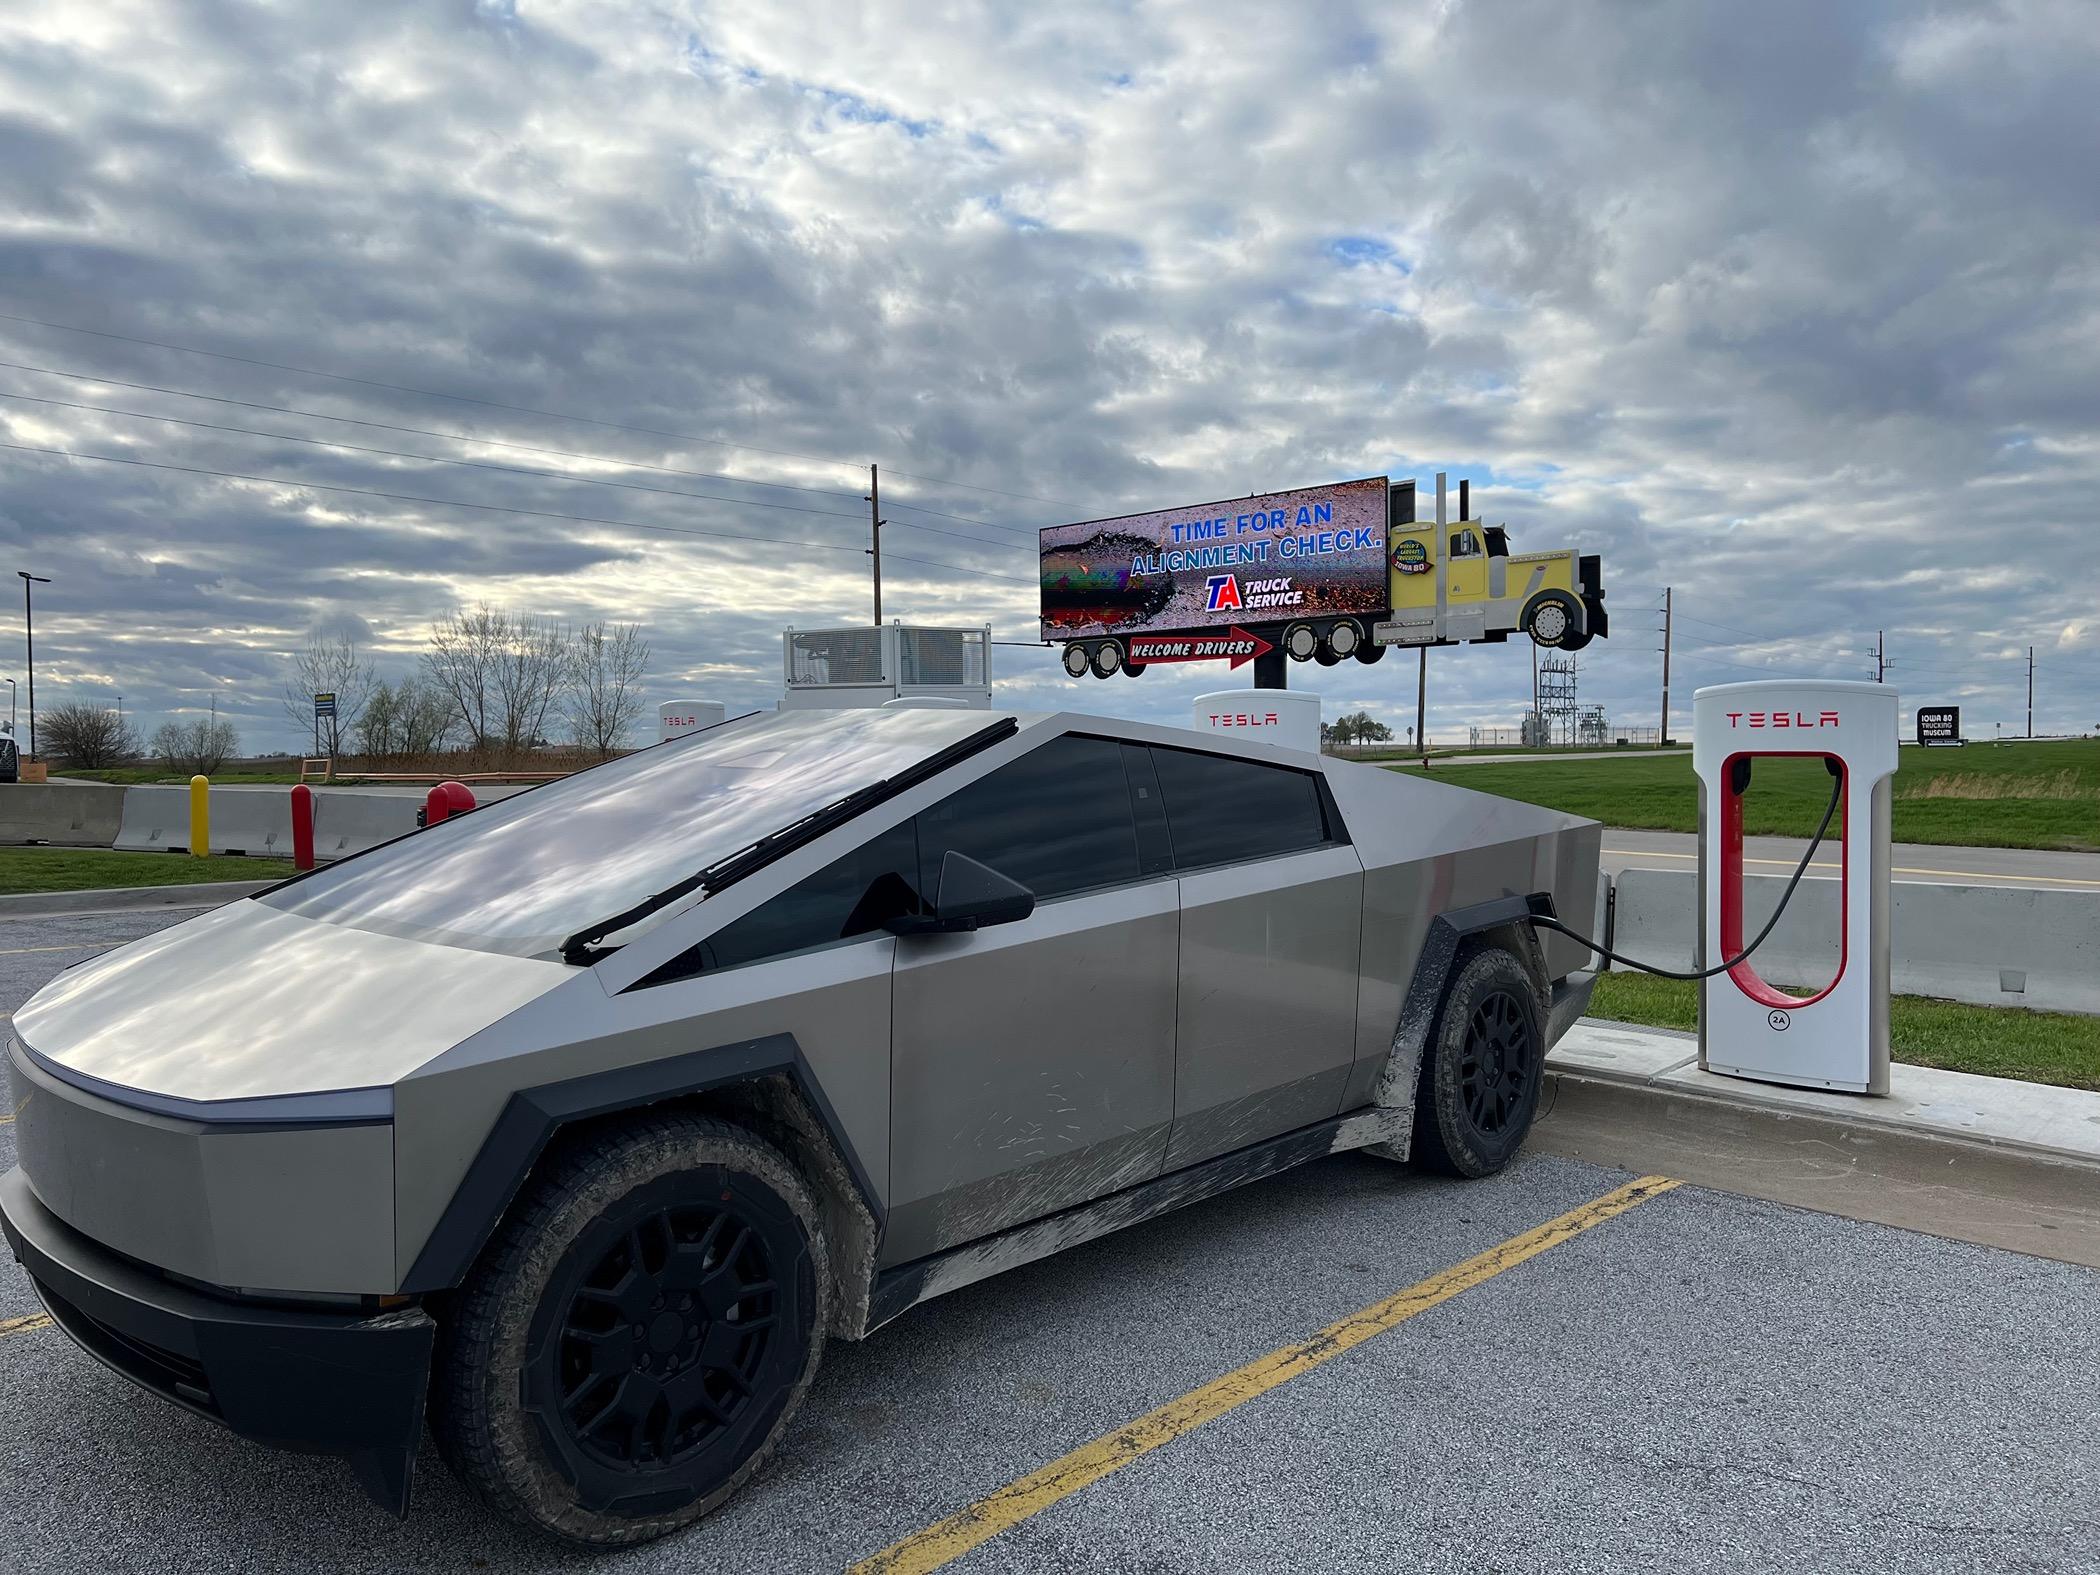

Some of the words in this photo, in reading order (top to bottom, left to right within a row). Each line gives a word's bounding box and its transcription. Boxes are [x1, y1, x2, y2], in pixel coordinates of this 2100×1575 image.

[1171, 517, 1227, 544] TIME
[1236, 508, 1287, 535] FOR
[1295, 502, 1333, 526] AN
[1130, 540, 1272, 577] ALIGNMENT
[1279, 527, 1383, 558] CHECK.
[1394, 561, 1412, 571] IOWA
[1413, 563, 1424, 571] 80
[1205, 573, 1243, 612] TA
[1245, 577, 1292, 594] TRUCK
[1131, 642, 1192, 658] WELCOME
[1194, 640, 1256, 656] DRIVERS
[663, 716, 696, 726] TESLA
[1209, 713, 1278, 727] TESLA
[1725, 711, 1839, 728] TESLA
[1943, 714, 1952, 722] 80
[1773, 1016, 1786, 1025] 2A
